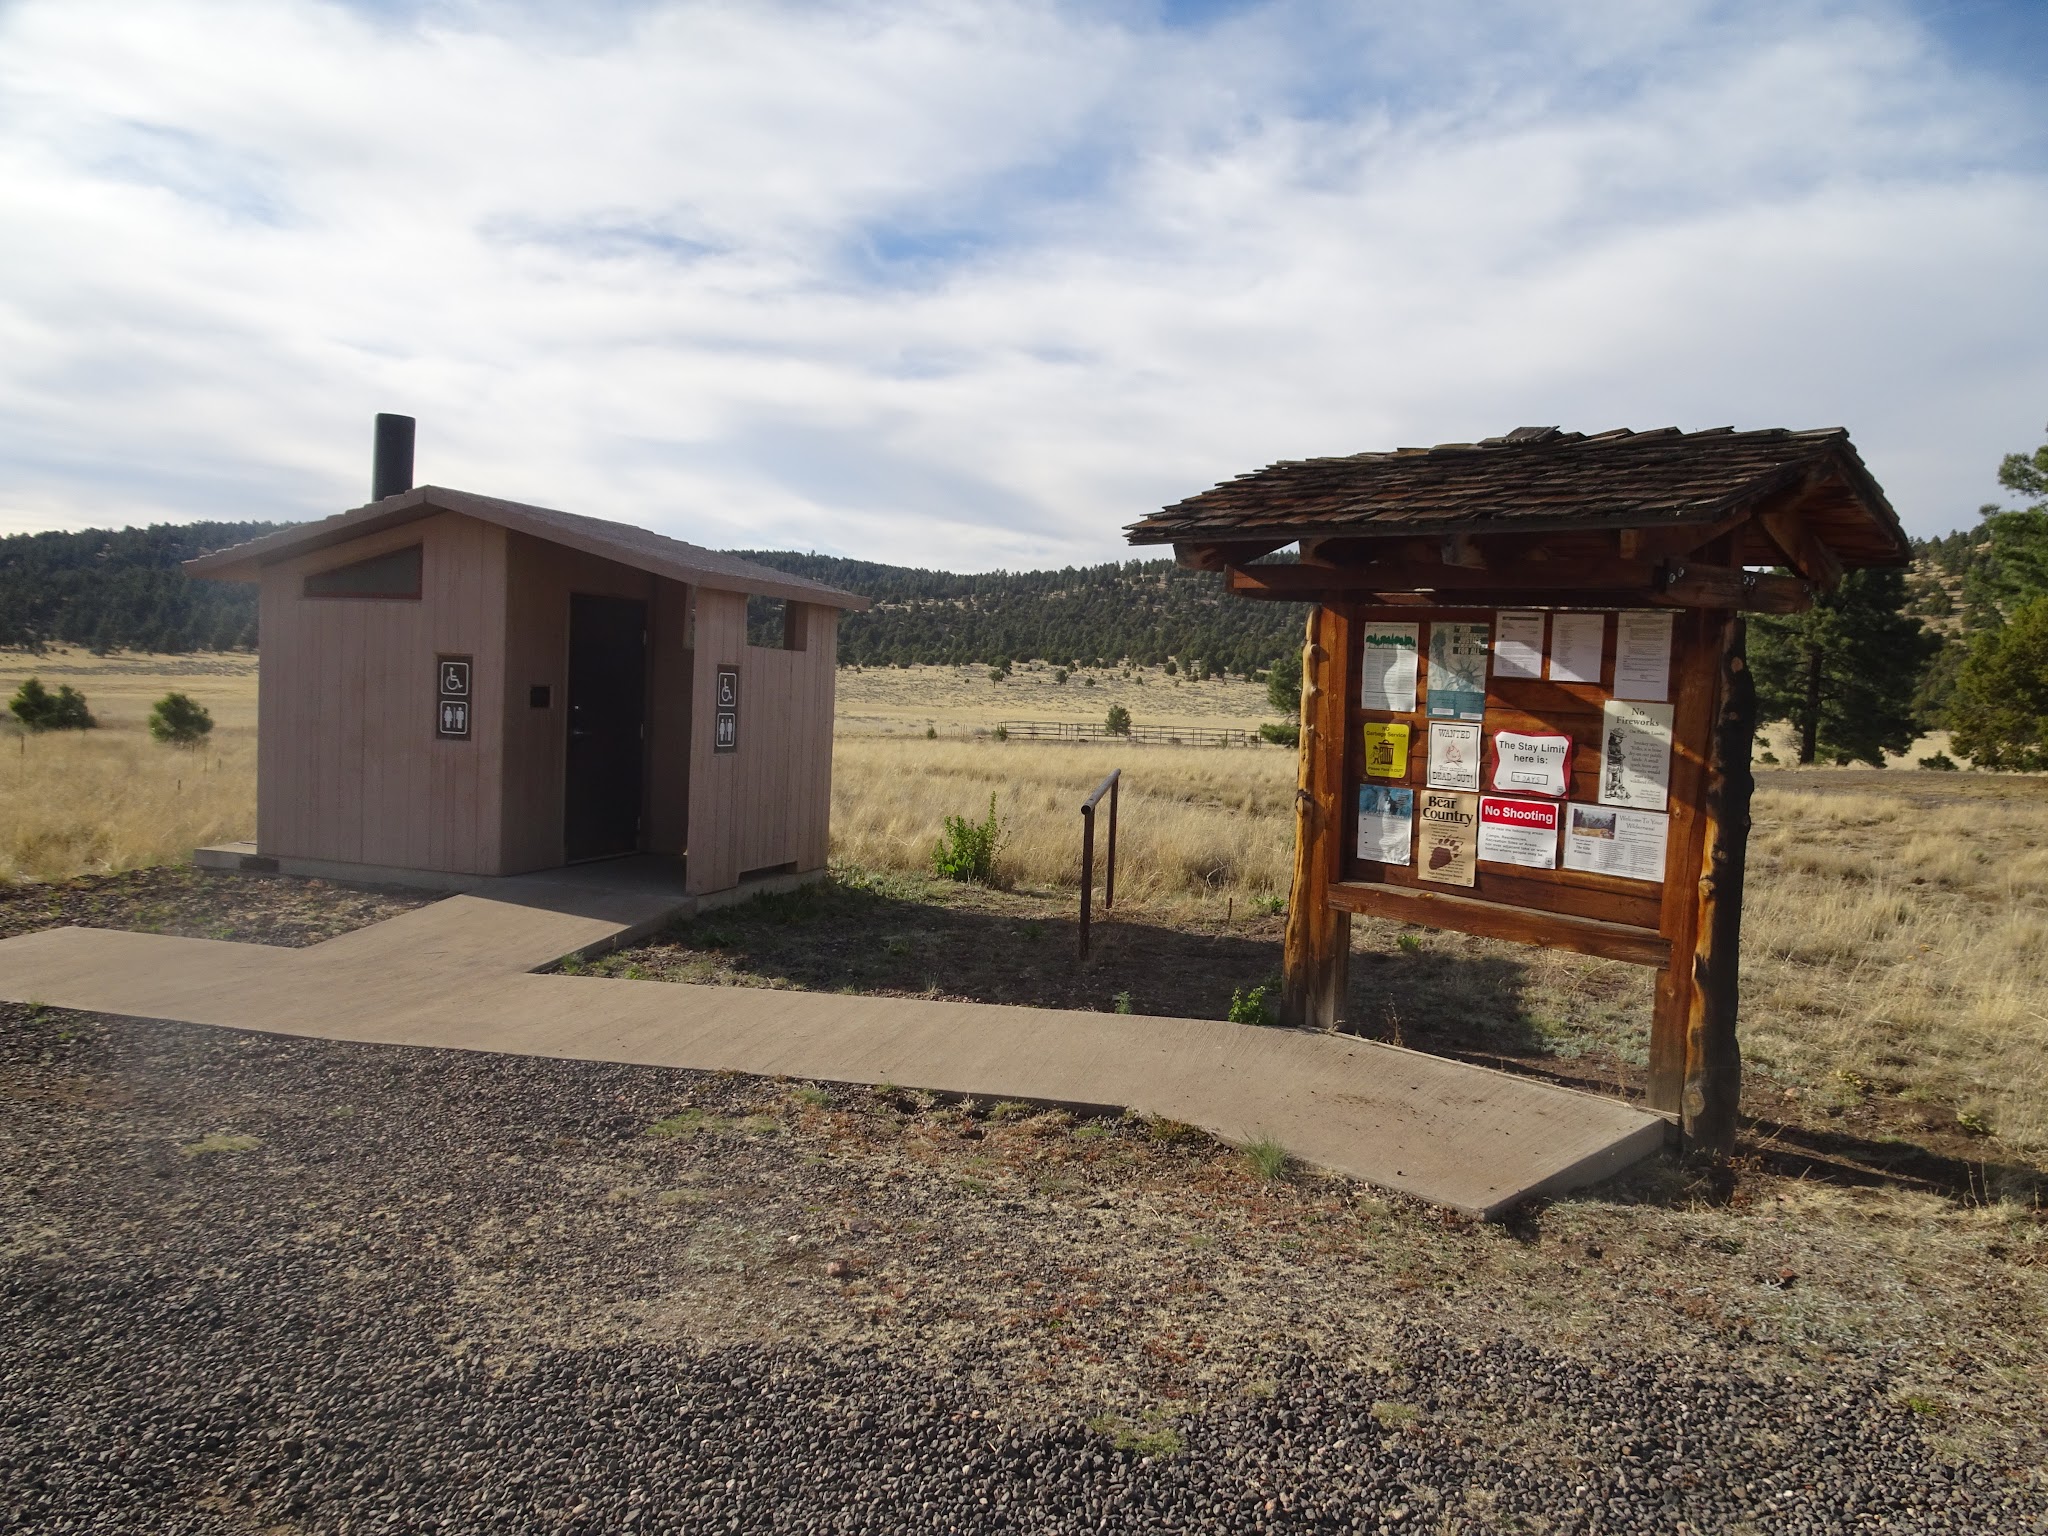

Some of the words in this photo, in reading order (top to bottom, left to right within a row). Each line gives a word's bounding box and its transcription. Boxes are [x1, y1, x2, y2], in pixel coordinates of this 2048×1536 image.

[1631, 707, 1645, 716] No
[1616, 715, 1659, 727] Fireworks
[1366, 730, 1386, 738] Garbage
[1438, 728, 1471, 739] WANTED
[1499, 740, 1516, 750] The
[1518, 741, 1538, 753] Stay
[1541, 743, 1565, 754] Limit
[1513, 753, 1534, 763] here
[1536, 755, 1548, 764] is:
[1428, 795, 1457, 809] Bear
[1422, 807, 1474, 828] Country
[1484, 804, 1501, 816] No
[1502, 806, 1554, 825] Shooting
